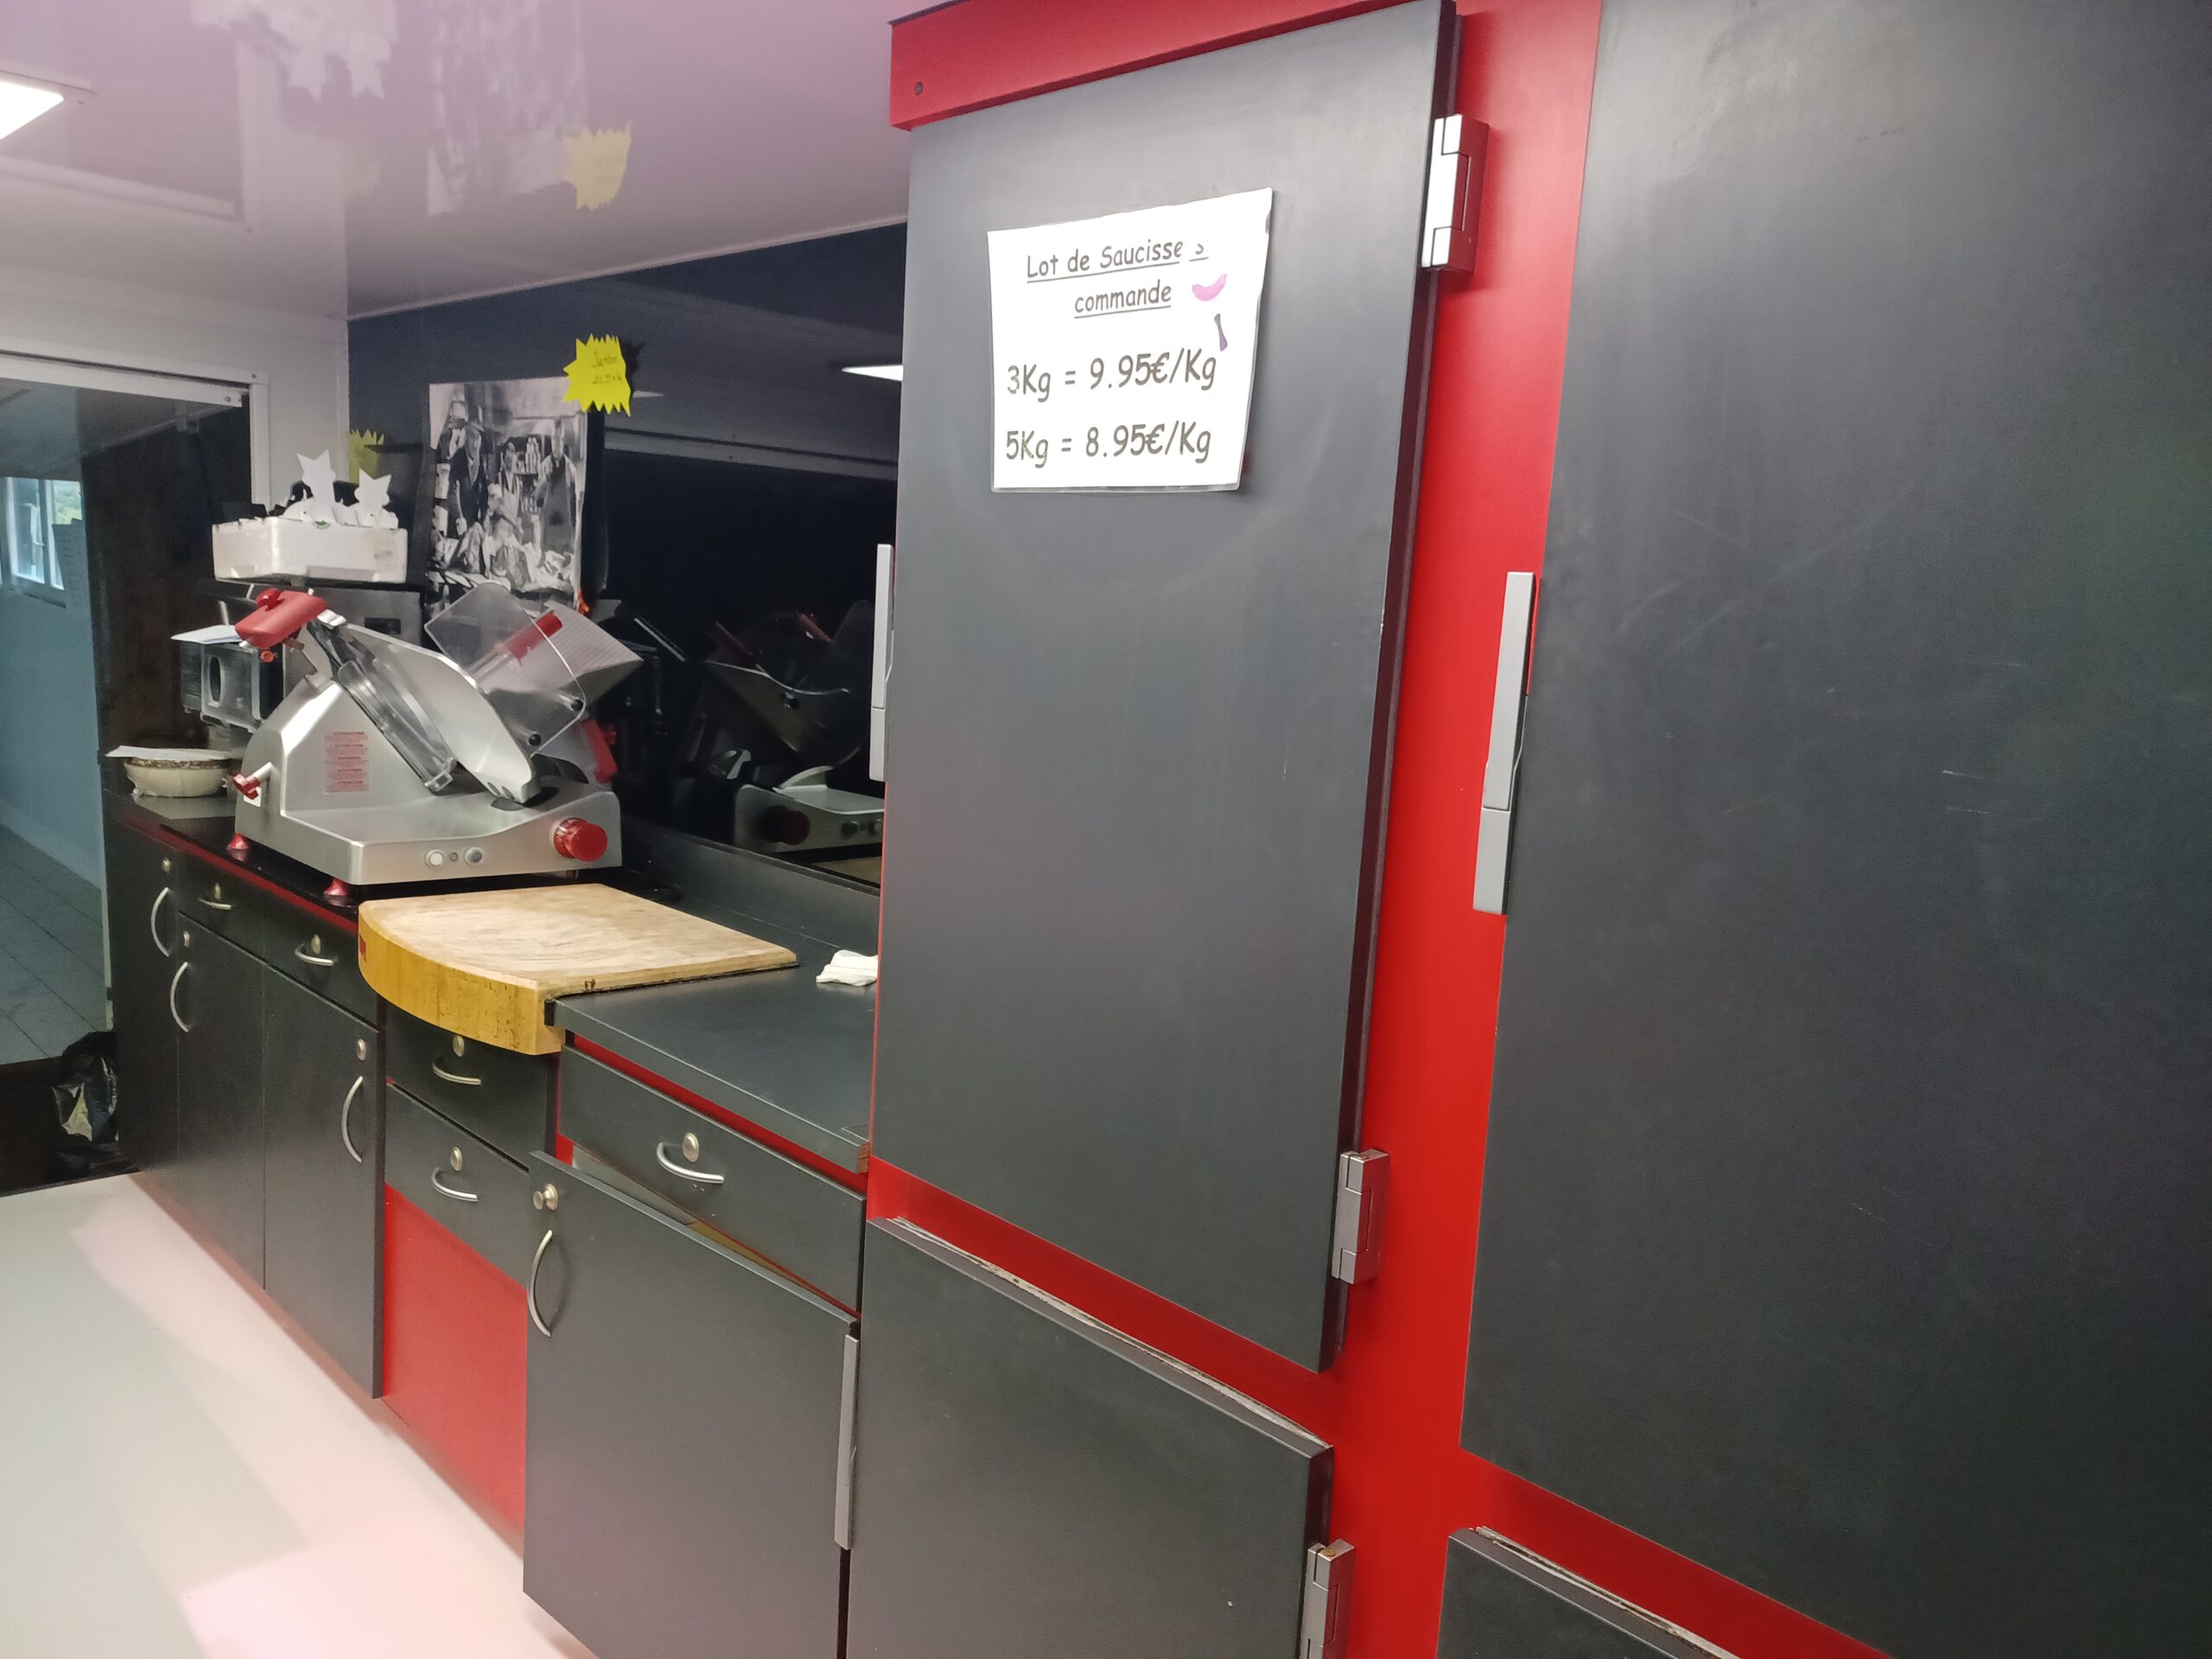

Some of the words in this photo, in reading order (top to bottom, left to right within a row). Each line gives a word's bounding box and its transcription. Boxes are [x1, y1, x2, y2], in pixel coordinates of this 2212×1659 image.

[1027, 255, 1058, 278] Lot
[1067, 248, 1090, 273] de
[1074, 278, 1172, 313] commande
[1007, 364, 1051, 403] 3Kg
[1065, 371, 1076, 385] =
[1090, 347, 1217, 391] 9.95€/Kg
[1007, 430, 1048, 468] 5Kg
[1061, 438, 1071, 452] =
[1086, 420, 1211, 464] 8.95€/Kg
